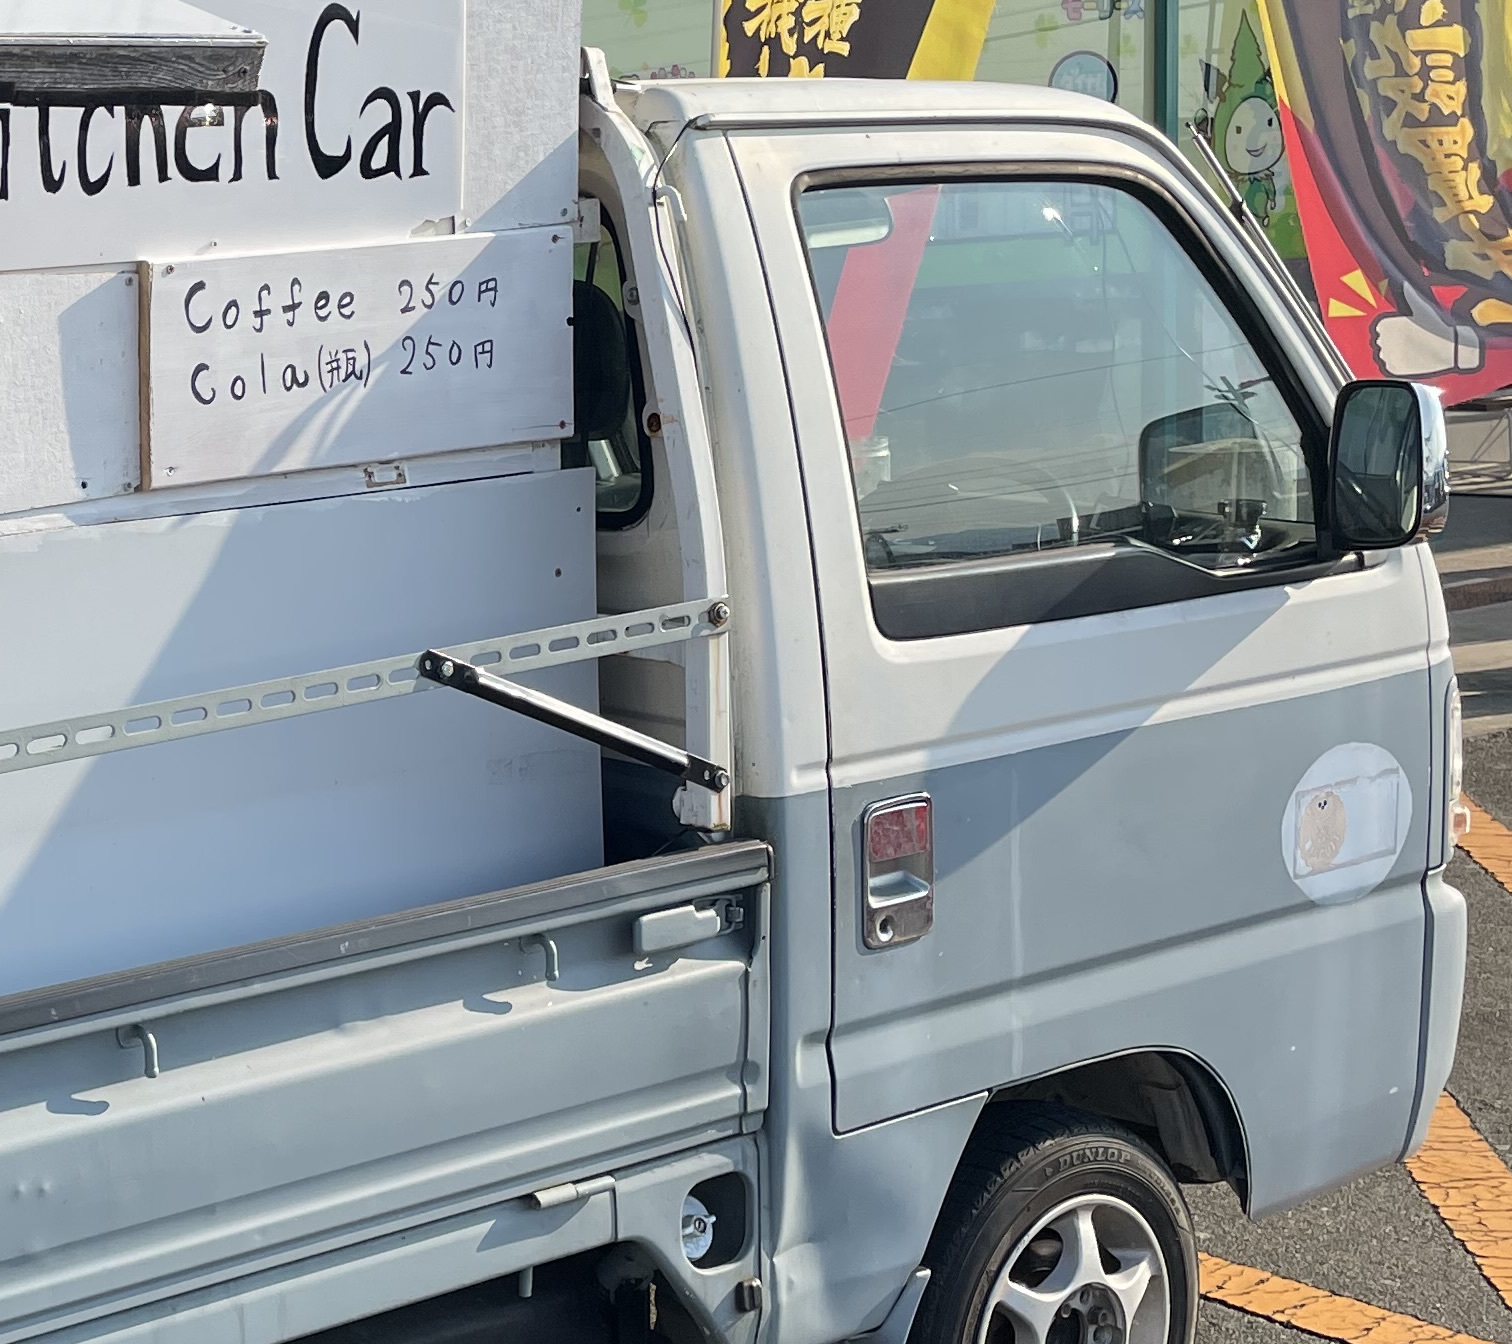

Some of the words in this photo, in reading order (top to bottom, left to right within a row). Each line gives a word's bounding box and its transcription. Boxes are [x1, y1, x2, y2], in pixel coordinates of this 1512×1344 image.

[304, 2, 456, 180] Car
[184, 277, 355, 334] Coffee
[398, 272, 499, 315] 250円
[399, 334, 494, 376] 250円
[1059, 1147, 1131, 1171] DUNLOP
